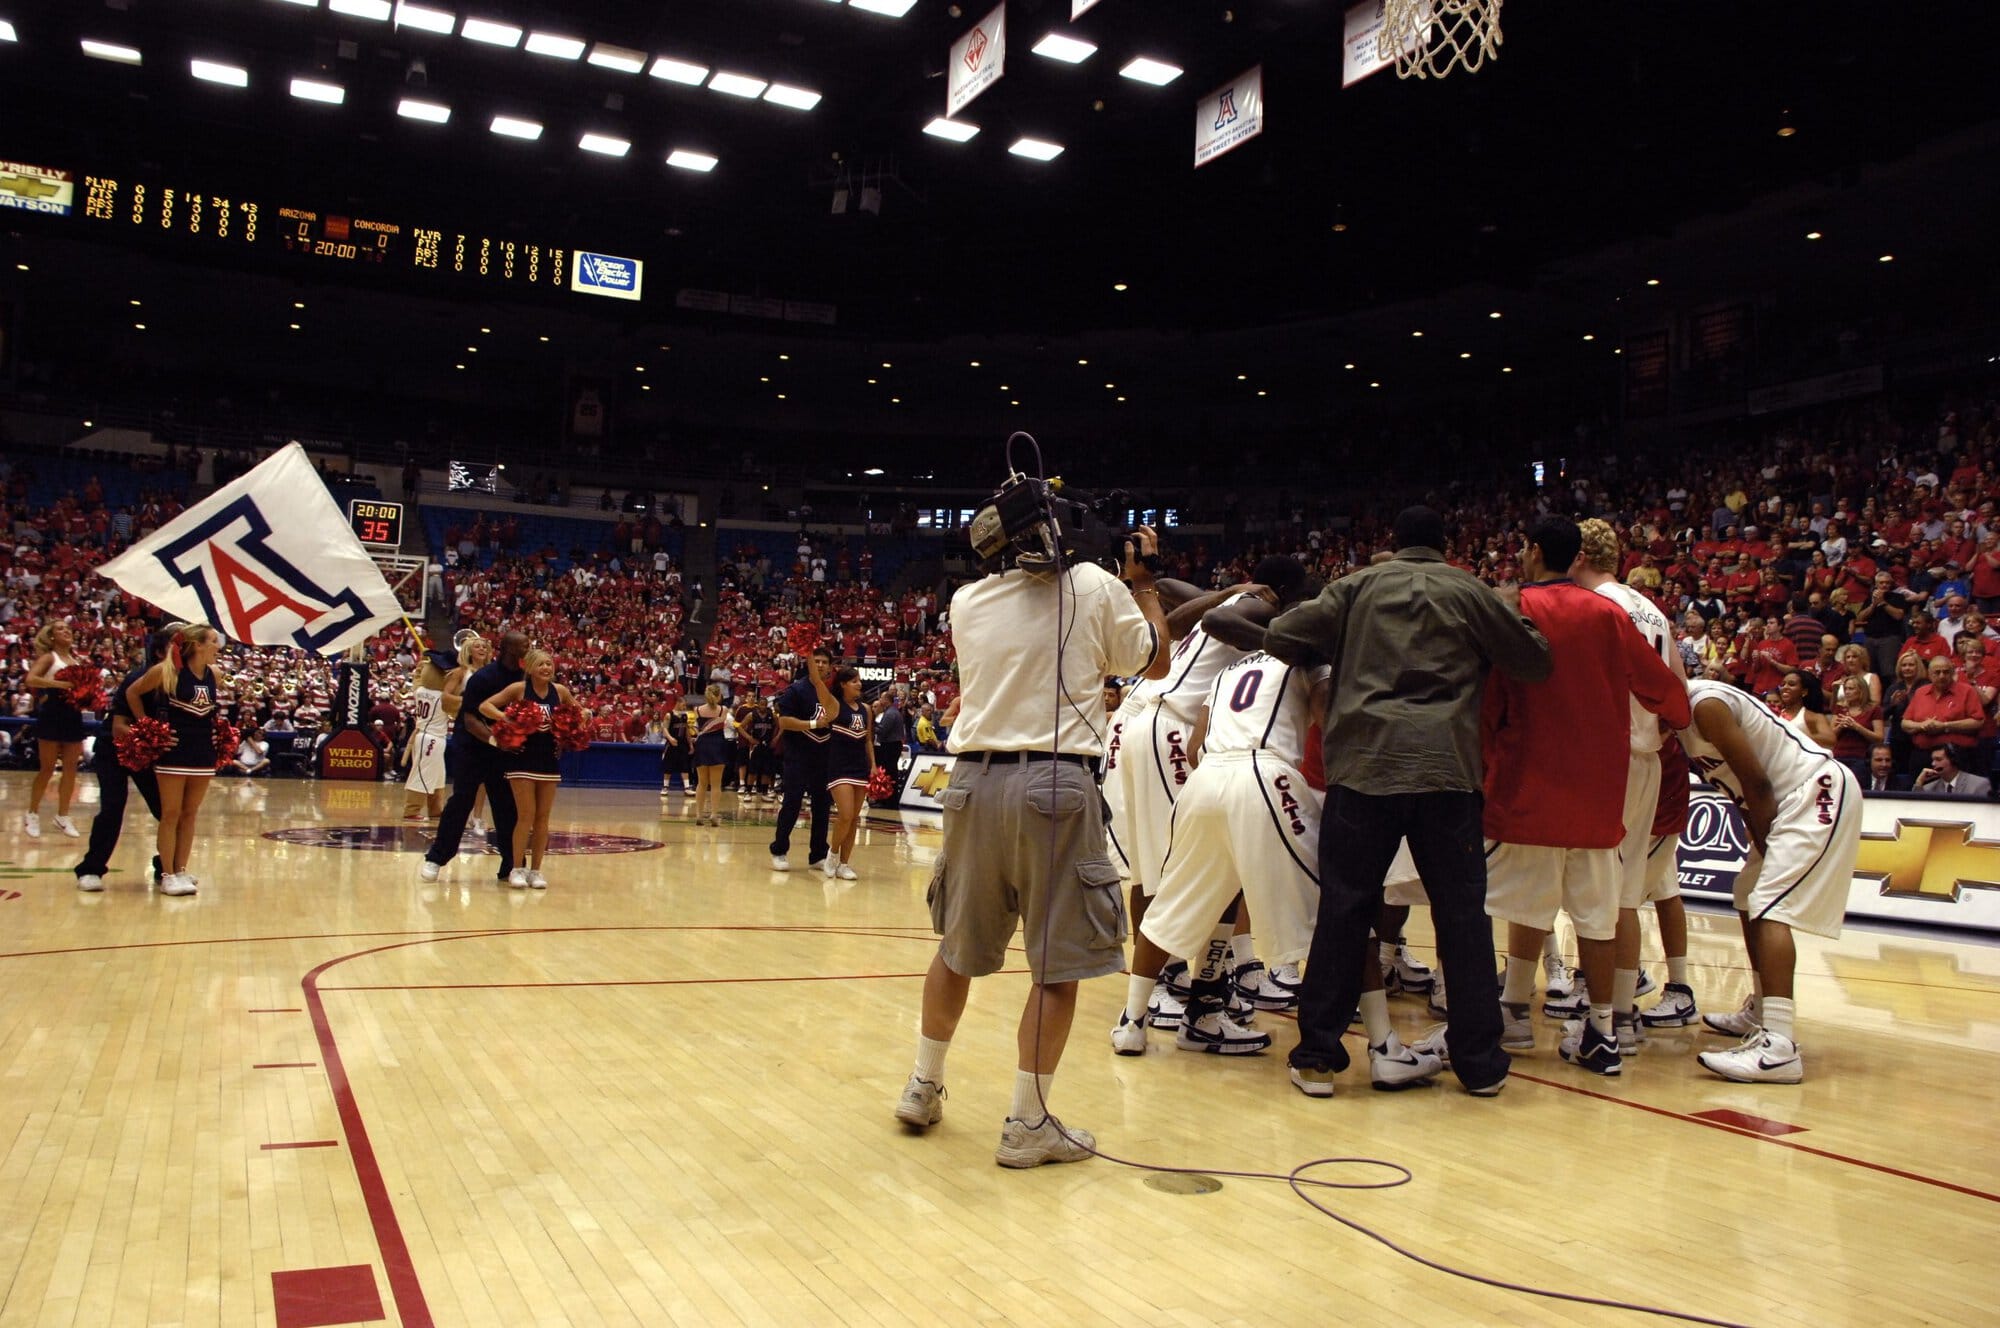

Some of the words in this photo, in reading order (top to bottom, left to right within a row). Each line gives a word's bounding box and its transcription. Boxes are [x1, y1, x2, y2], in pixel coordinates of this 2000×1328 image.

[1215, 88, 1237, 131] A
[85, 176, 118, 191] PLYR
[164, 188, 174, 199] 5
[186, 192, 202, 204] 14
[212, 196, 230, 209] 34
[240, 202, 258, 213] 43
[279, 208, 317, 222] ARIZONA
[298, 222, 309, 236] 0
[354, 219, 400, 235] CONCORDIA
[377, 234, 388, 248] 0
[413, 228, 442, 241] PLYR
[482, 238, 490, 248] 9
[500, 241, 514, 252] 10
[525, 244, 539, 255] 12
[549, 248, 563, 259] 15
[418, 238, 437, 250] PTS
[314, 241, 357, 259] 20:00
[415, 247, 438, 259] RBS
[414, 256, 438, 268] FLS
[593, 257, 625, 271] Tucson
[596, 266, 631, 279] Electric
[599, 274, 631, 287] Power
[357, 504, 397, 519] 20:00
[361, 521, 389, 541] 35
[152, 493, 375, 654] A
[347, 667, 361, 725] ARIZONA
[1229, 669, 1264, 713] 0
[329, 748, 374, 758] WELLS
[1108, 723, 1123, 769] CATS
[330, 758, 373, 768] FARGO
[1167, 730, 1188, 785] CATS
[1274, 774, 1306, 836] CATS
[1815, 774, 1834, 825] CATS
[1199, 940, 1228, 979] CATS
